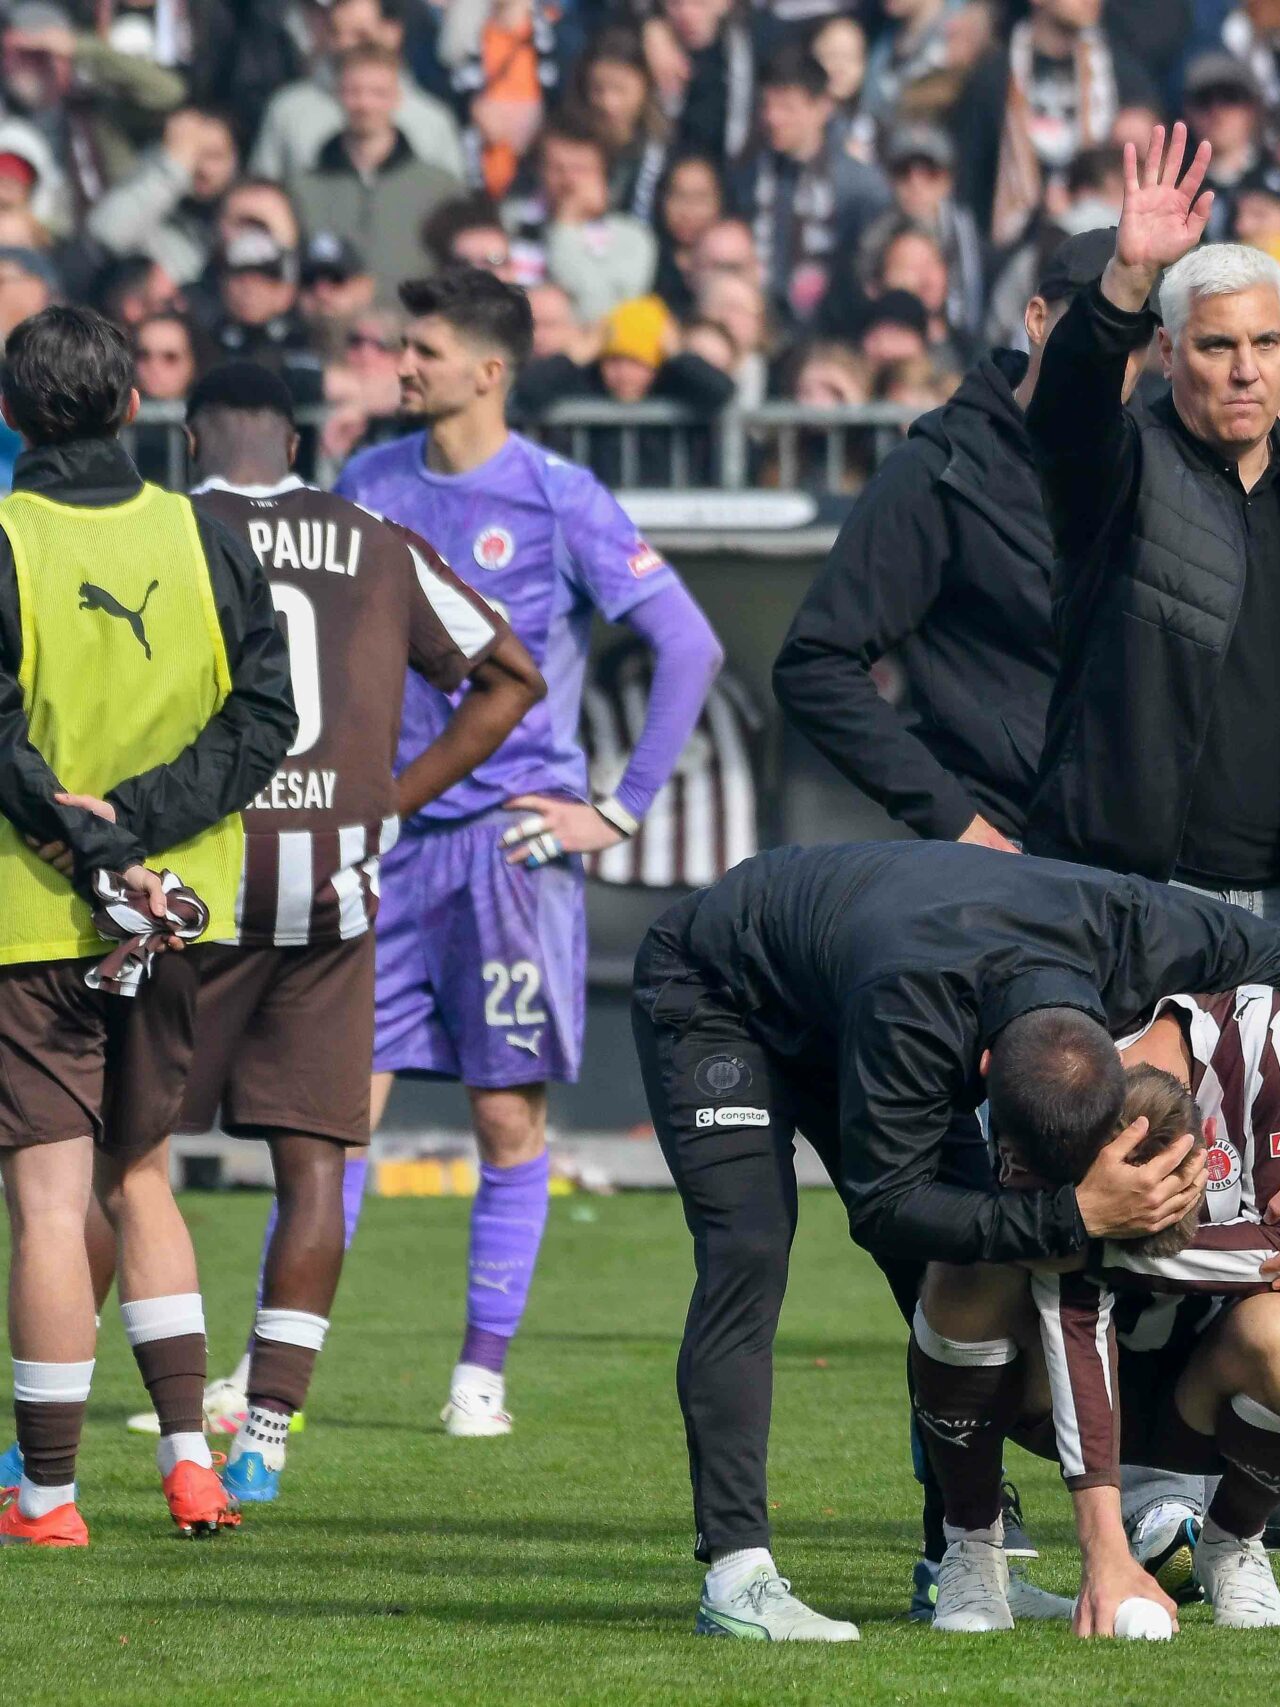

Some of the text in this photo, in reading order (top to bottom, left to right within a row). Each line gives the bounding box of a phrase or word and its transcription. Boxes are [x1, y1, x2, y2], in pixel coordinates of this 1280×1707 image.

[248, 519, 361, 577] PAULI
[245, 771, 336, 809] ESAY
[483, 962, 546, 1026] 22
[1213, 1141, 1237, 1159] PAULI
[1211, 1178, 1231, 1189] 1910
